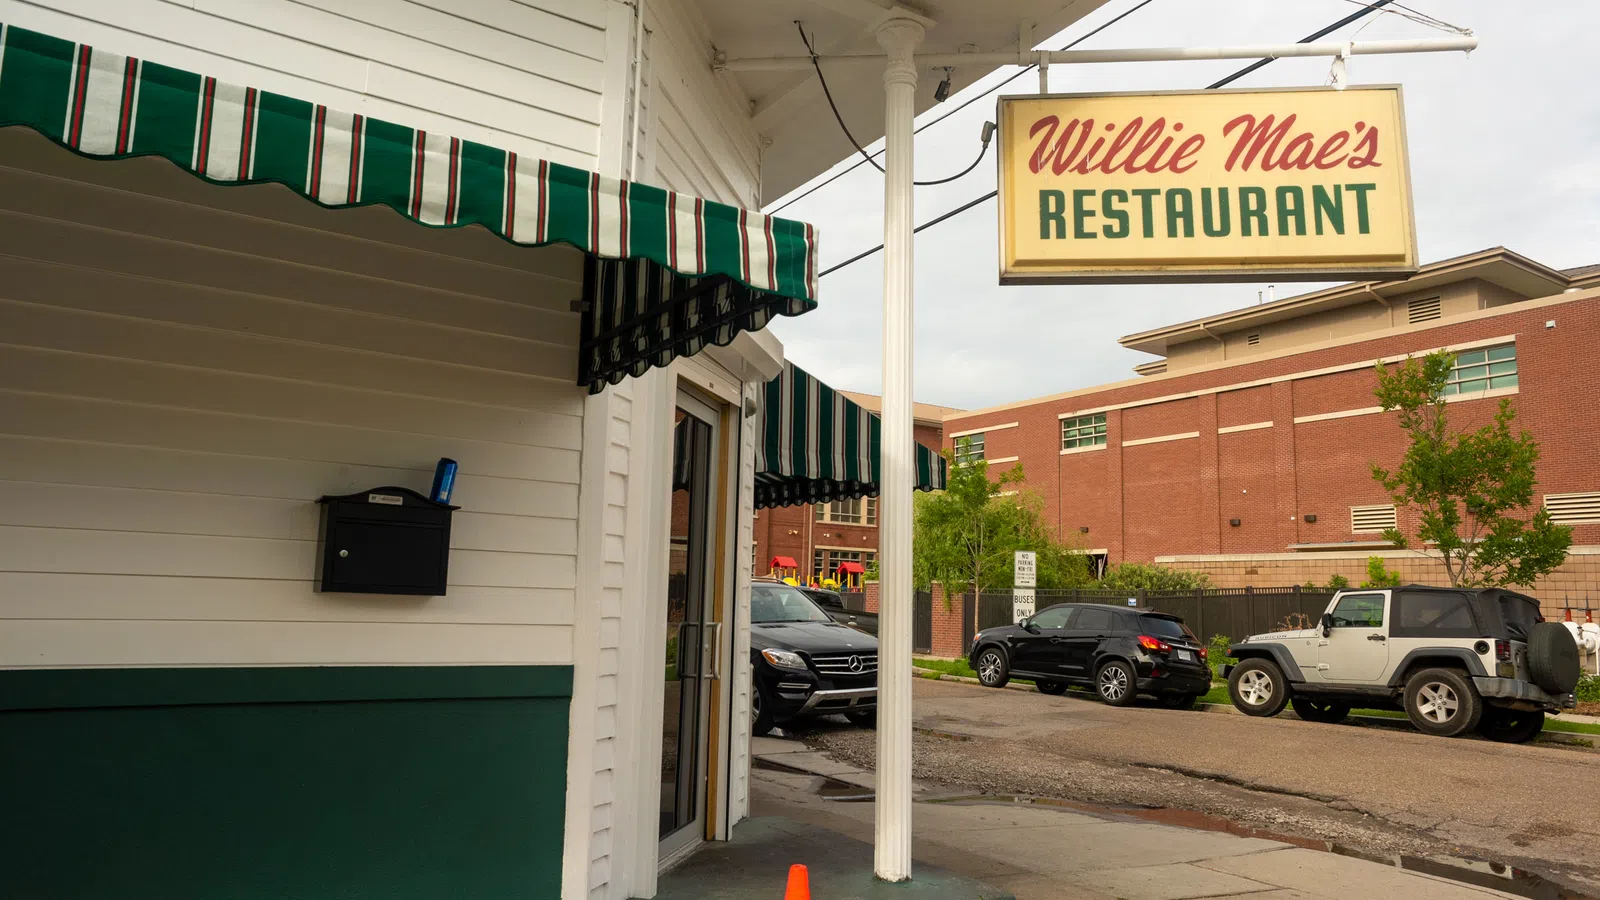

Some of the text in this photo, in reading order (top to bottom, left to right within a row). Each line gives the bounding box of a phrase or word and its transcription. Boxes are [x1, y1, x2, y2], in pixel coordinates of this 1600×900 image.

[1029, 114, 1381, 176] Willie Mae's
[1040, 184, 1377, 239] RESTAURANT
[1014, 595, 1034, 604] BUSES
[1017, 609, 1032, 617] ONLY
